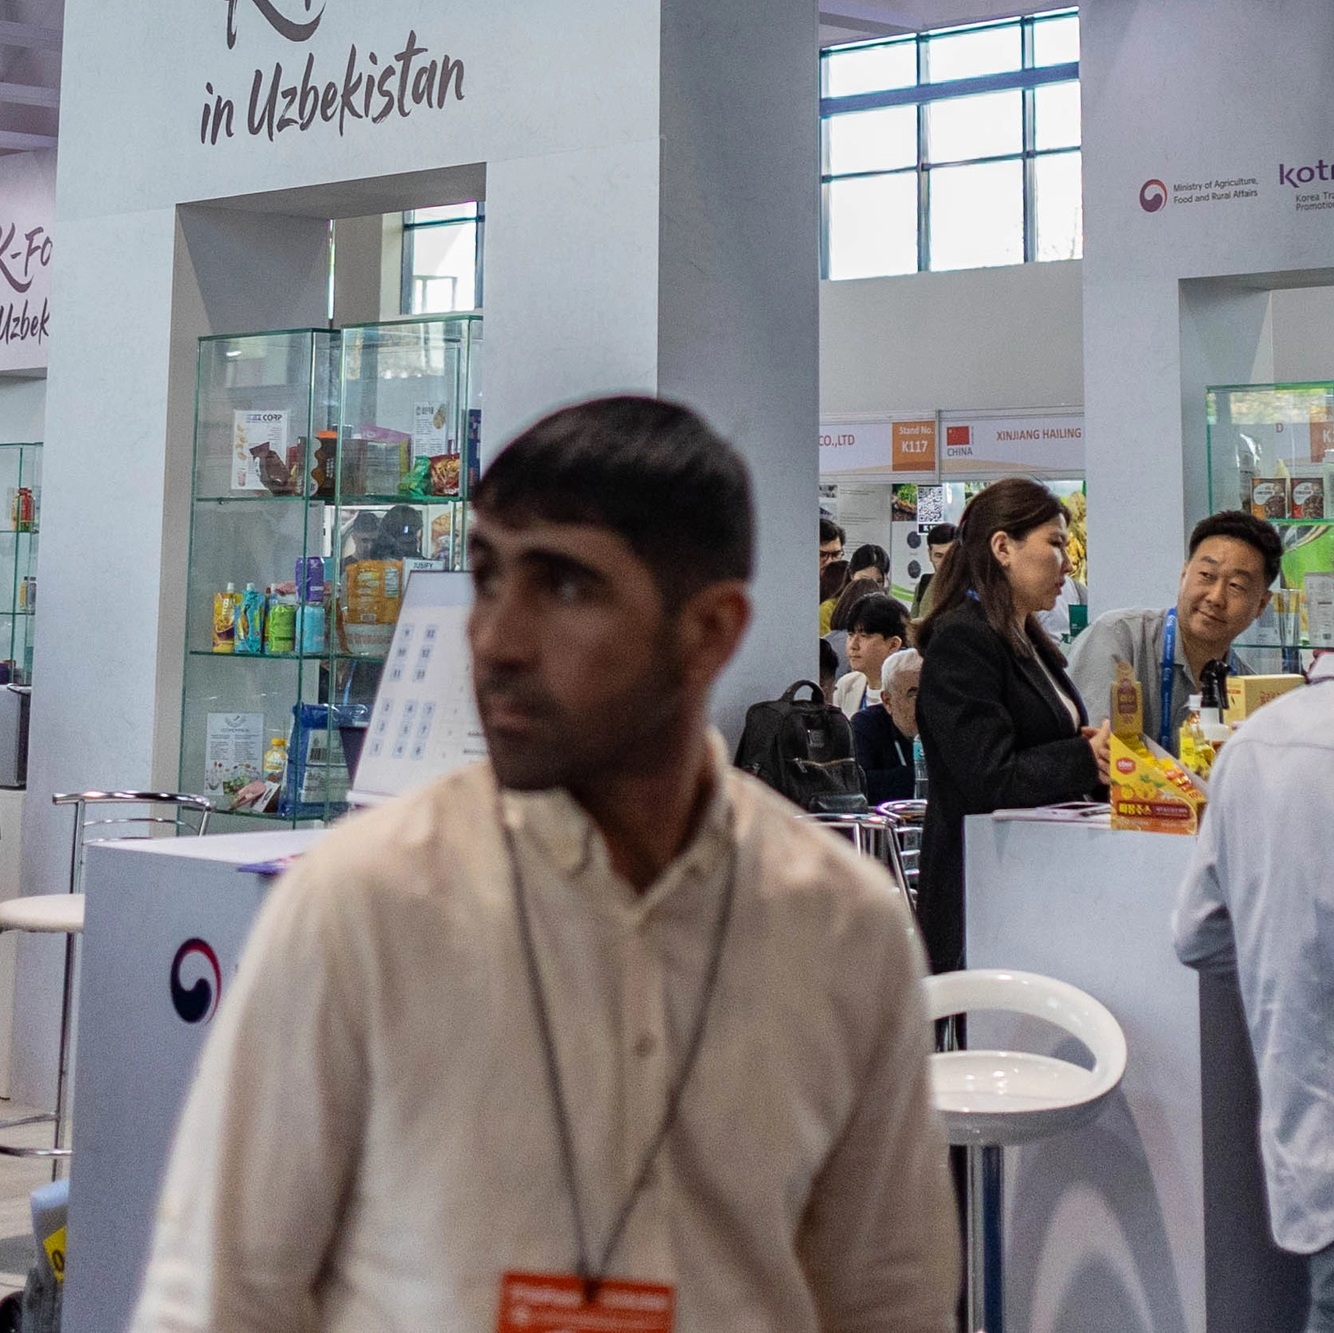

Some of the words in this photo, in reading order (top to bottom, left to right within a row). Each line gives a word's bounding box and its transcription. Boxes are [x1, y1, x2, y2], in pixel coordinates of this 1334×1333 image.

[201, 81, 234, 146] in
[248, 29, 465, 142] Uzbekistan
[1173, 182, 1203, 193] Ministry
[1204, 180, 1213, 190] of
[1173, 195, 1193, 204] Food
[1195, 193, 1210, 202] and
[1211, 191, 1231, 200] Rural
[1233, 188, 1258, 199] Affairs
[1295, 193, 1320, 203] Korea
[996, 430, 1040, 441] XINJIANG
[1042, 427, 1082, 439] HAILING
[901, 440, 928, 454] K117
[947, 446, 973, 457] CHINA
